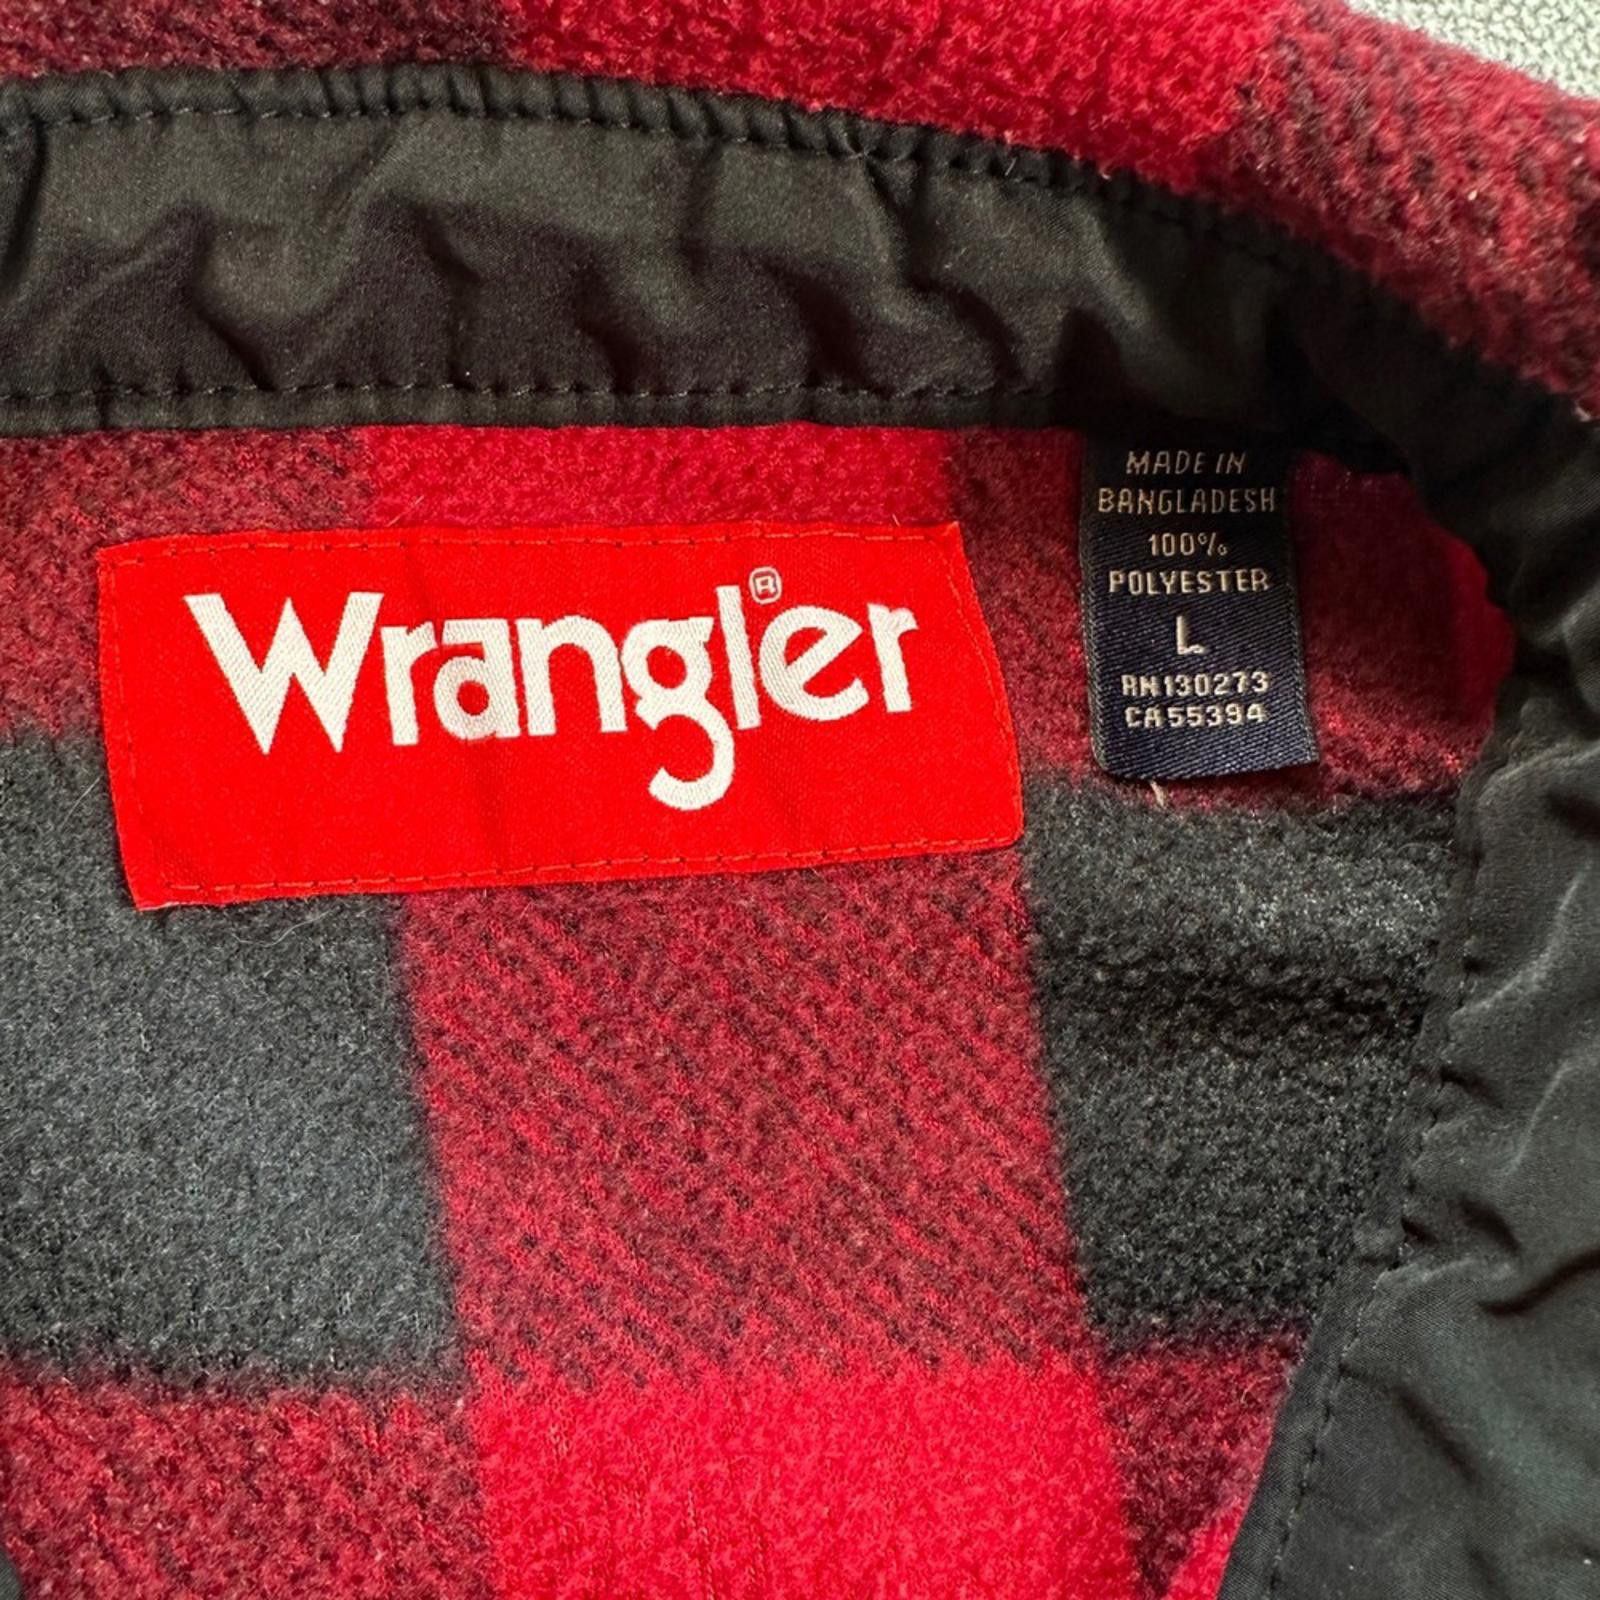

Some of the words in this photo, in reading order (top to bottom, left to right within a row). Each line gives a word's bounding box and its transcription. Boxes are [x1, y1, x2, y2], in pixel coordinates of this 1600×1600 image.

[1125, 450, 1205, 475] MADE
[1215, 451, 1246, 475] IN
[1097, 487, 1277, 515] BANGLADESH
[1148, 532, 1228, 557] 100%
[1108, 568, 1270, 595] POLYESTER
[1175, 614, 1206, 656] L
[184, 584, 918, 811] Wrangler
